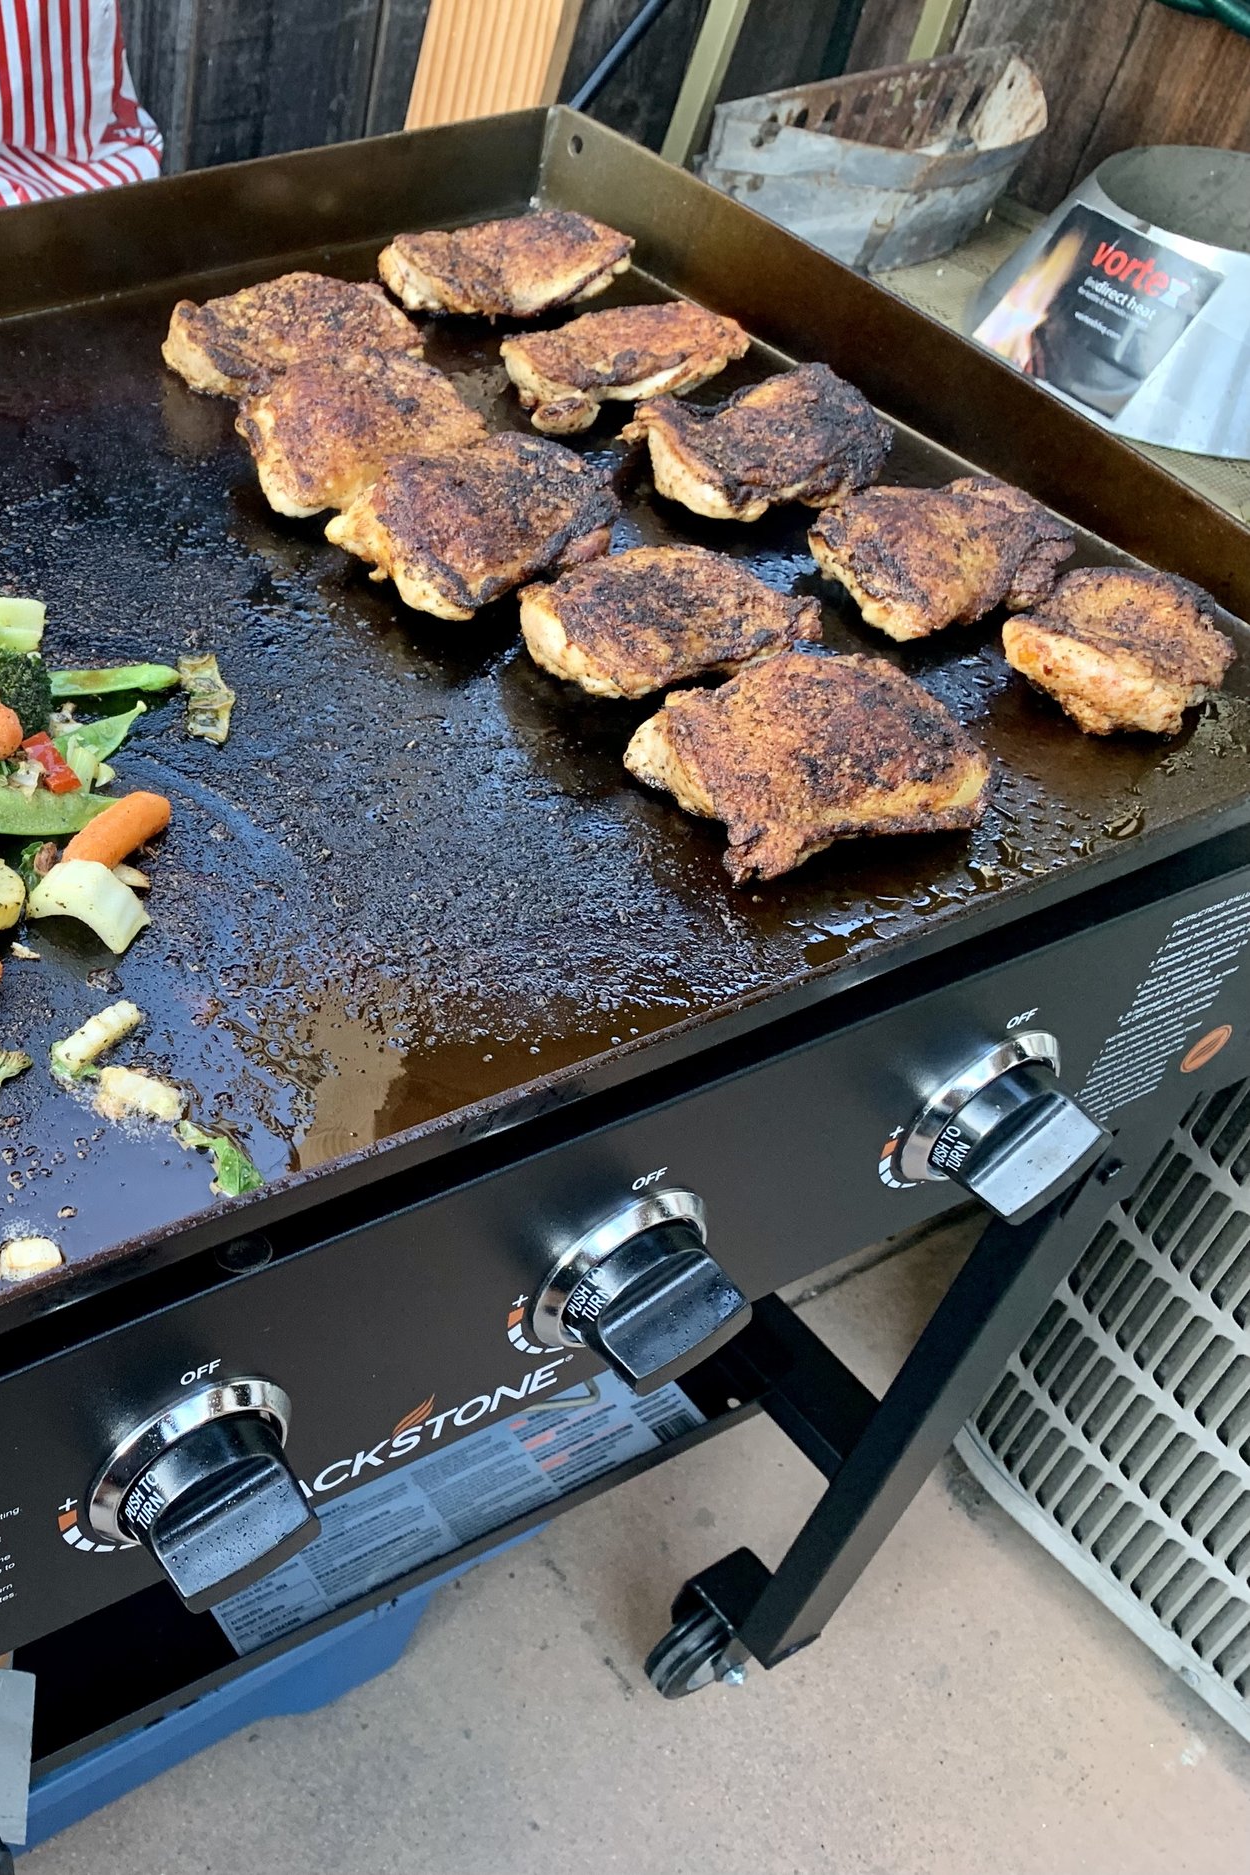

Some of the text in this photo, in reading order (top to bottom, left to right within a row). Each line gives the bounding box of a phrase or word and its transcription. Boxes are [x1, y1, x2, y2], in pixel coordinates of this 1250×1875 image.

[1006, 1007, 1039, 1030] OFF
[932, 1125, 961, 1168] PUSH TO
[945, 1141, 972, 1172] TURN
[632, 1166, 668, 1191] OFF
[567, 1268, 606, 1318] PUSH TO
[581, 1289, 611, 1322] TURN
[180, 1359, 222, 1386] OFF
[124, 1471, 158, 1524] PUSH TO
[136, 1494, 166, 1530] TURN
